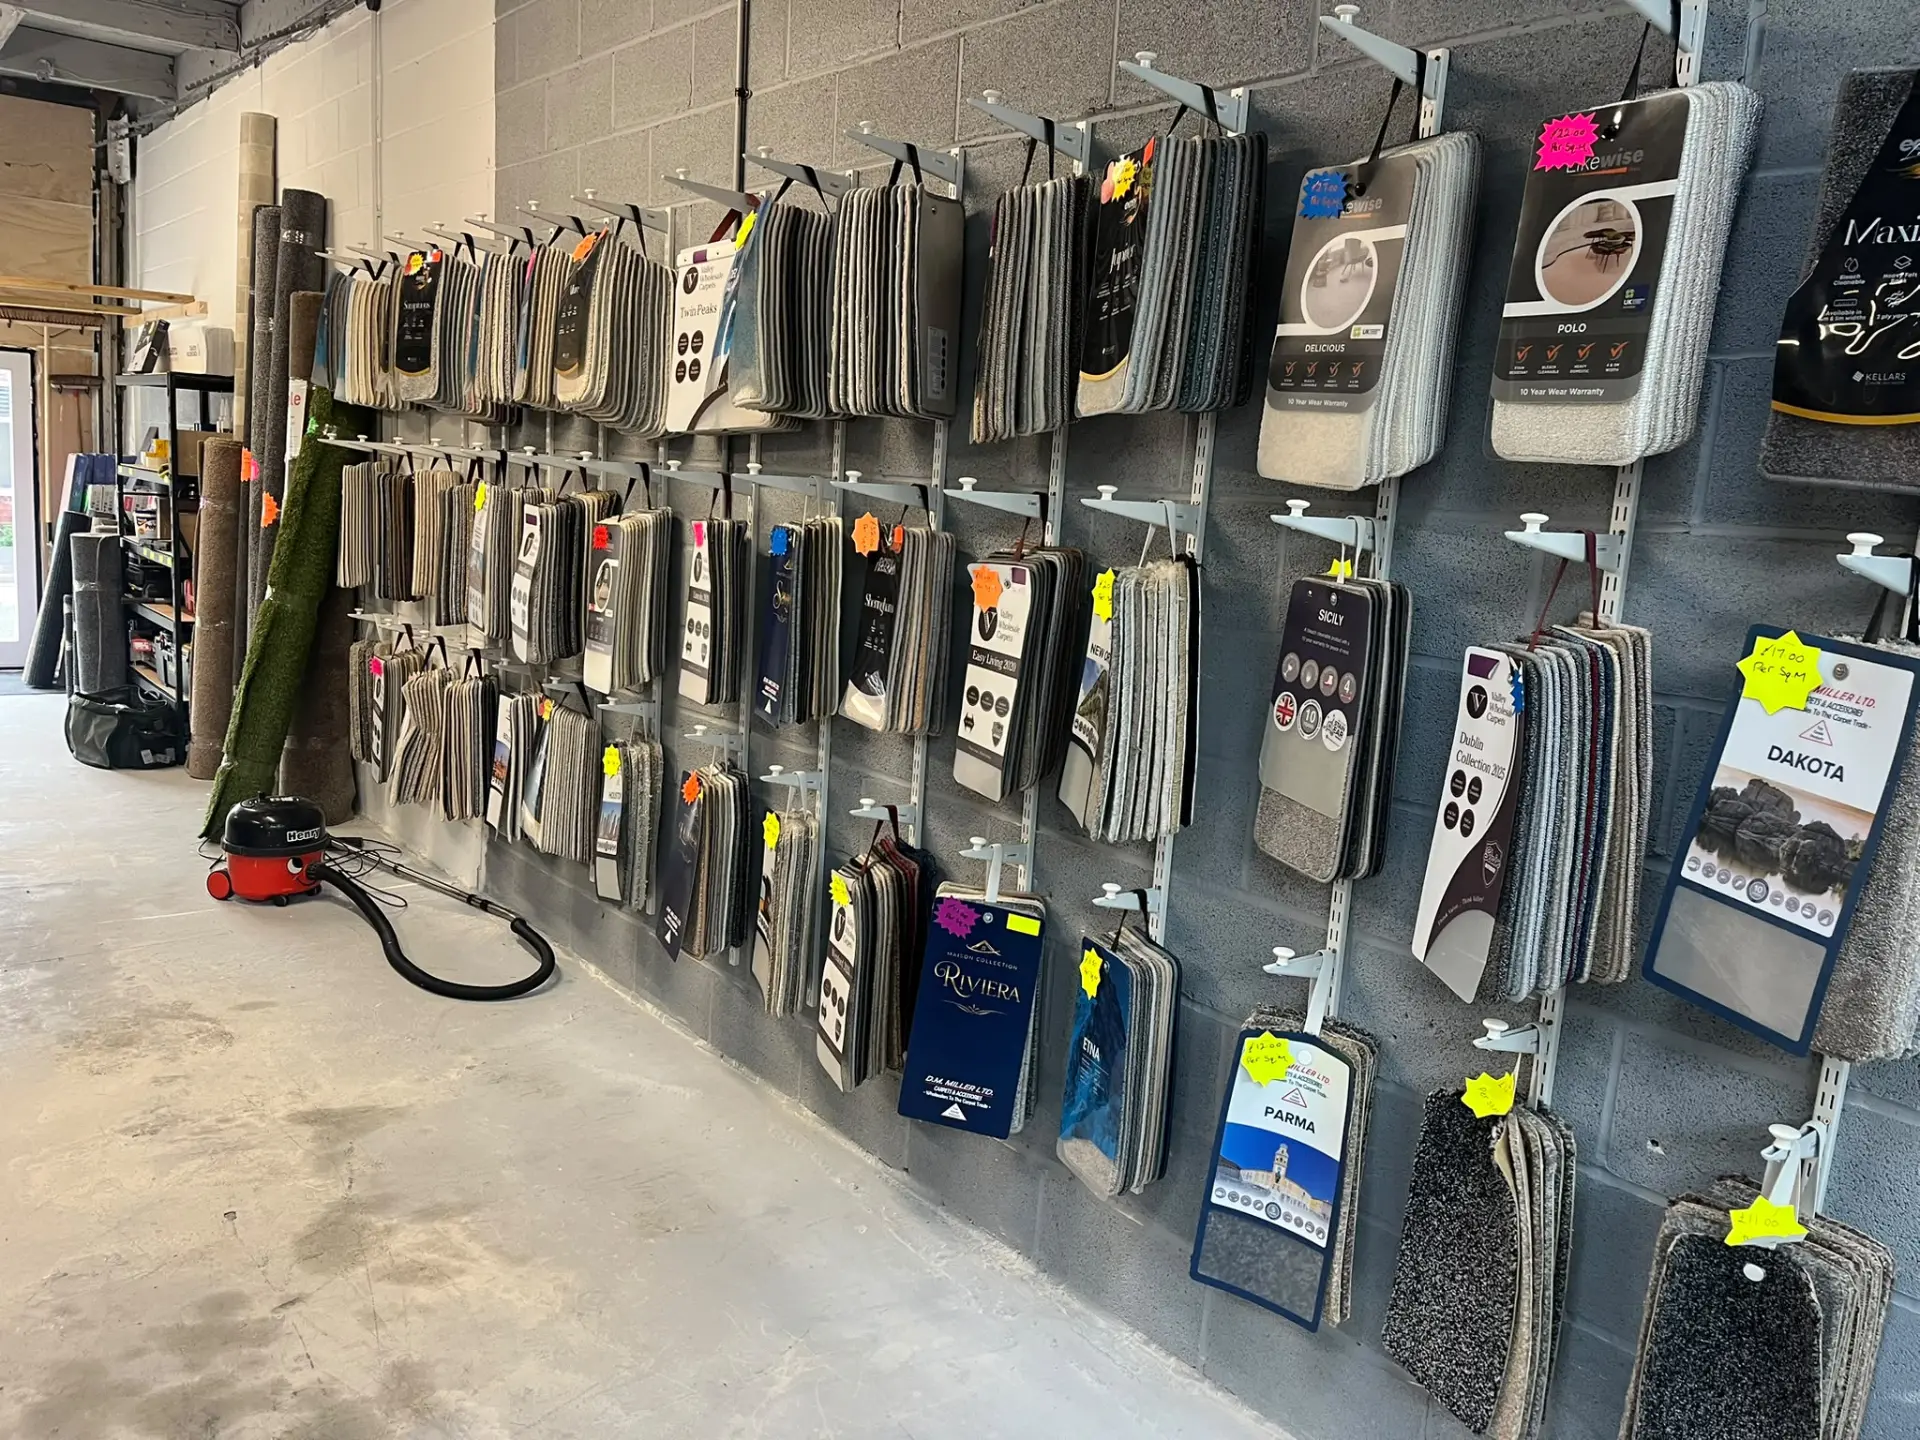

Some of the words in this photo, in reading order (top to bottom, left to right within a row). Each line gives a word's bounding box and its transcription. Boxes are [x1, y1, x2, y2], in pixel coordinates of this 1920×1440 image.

[680, 305, 697, 318] Twin
[697, 303, 718, 316] Peaks
[1557, 323, 1587, 334] POLO
[1304, 344, 1346, 353] DELICIOUS
[1865, 372, 1906, 381] KELLARS
[1520, 388, 1529, 396] 10
[1530, 388, 1546, 396] Year
[1548, 388, 1567, 396] Wear
[1569, 387, 1605, 397] Warranty
[1324, 398, 1349, 407] Warranty
[1318, 608, 1344, 626] SICILY
[972, 650, 987, 665] Easy
[986, 653, 1004, 671] Living
[1753, 661, 1775, 674] Per
[1343, 679, 1351, 694] 4
[1491, 691, 1506, 704] Valley
[1855, 695, 1876, 709] LTD.
[1305, 708, 1317, 724] 10
[1826, 701, 1864, 718] ACCESSORIES
[1486, 711, 1506, 726] Carpets
[1813, 707, 1821, 716] To
[1821, 710, 1832, 720] The
[1832, 714, 1852, 725] Carpet
[1852, 718, 1868, 729] Trade
[1459, 731, 1484, 751] Dublin
[1456, 749, 1491, 775] Collection
[1490, 763, 1506, 781] 2025
[1767, 744, 1844, 783] DAKOTA
[286, 827, 320, 843] Henry
[946, 951, 974, 961] MAISON
[975, 956, 1018, 971] COLLECTION
[934, 960, 1020, 1004] RIVIERA
[1082, 1037, 1101, 1063] ETNA
[925, 1074, 944, 1085] D.M.
[944, 1079, 976, 1092] MILLER
[975, 1086, 994, 1096] LTD.
[1264, 1106, 1315, 1134] PARMA
